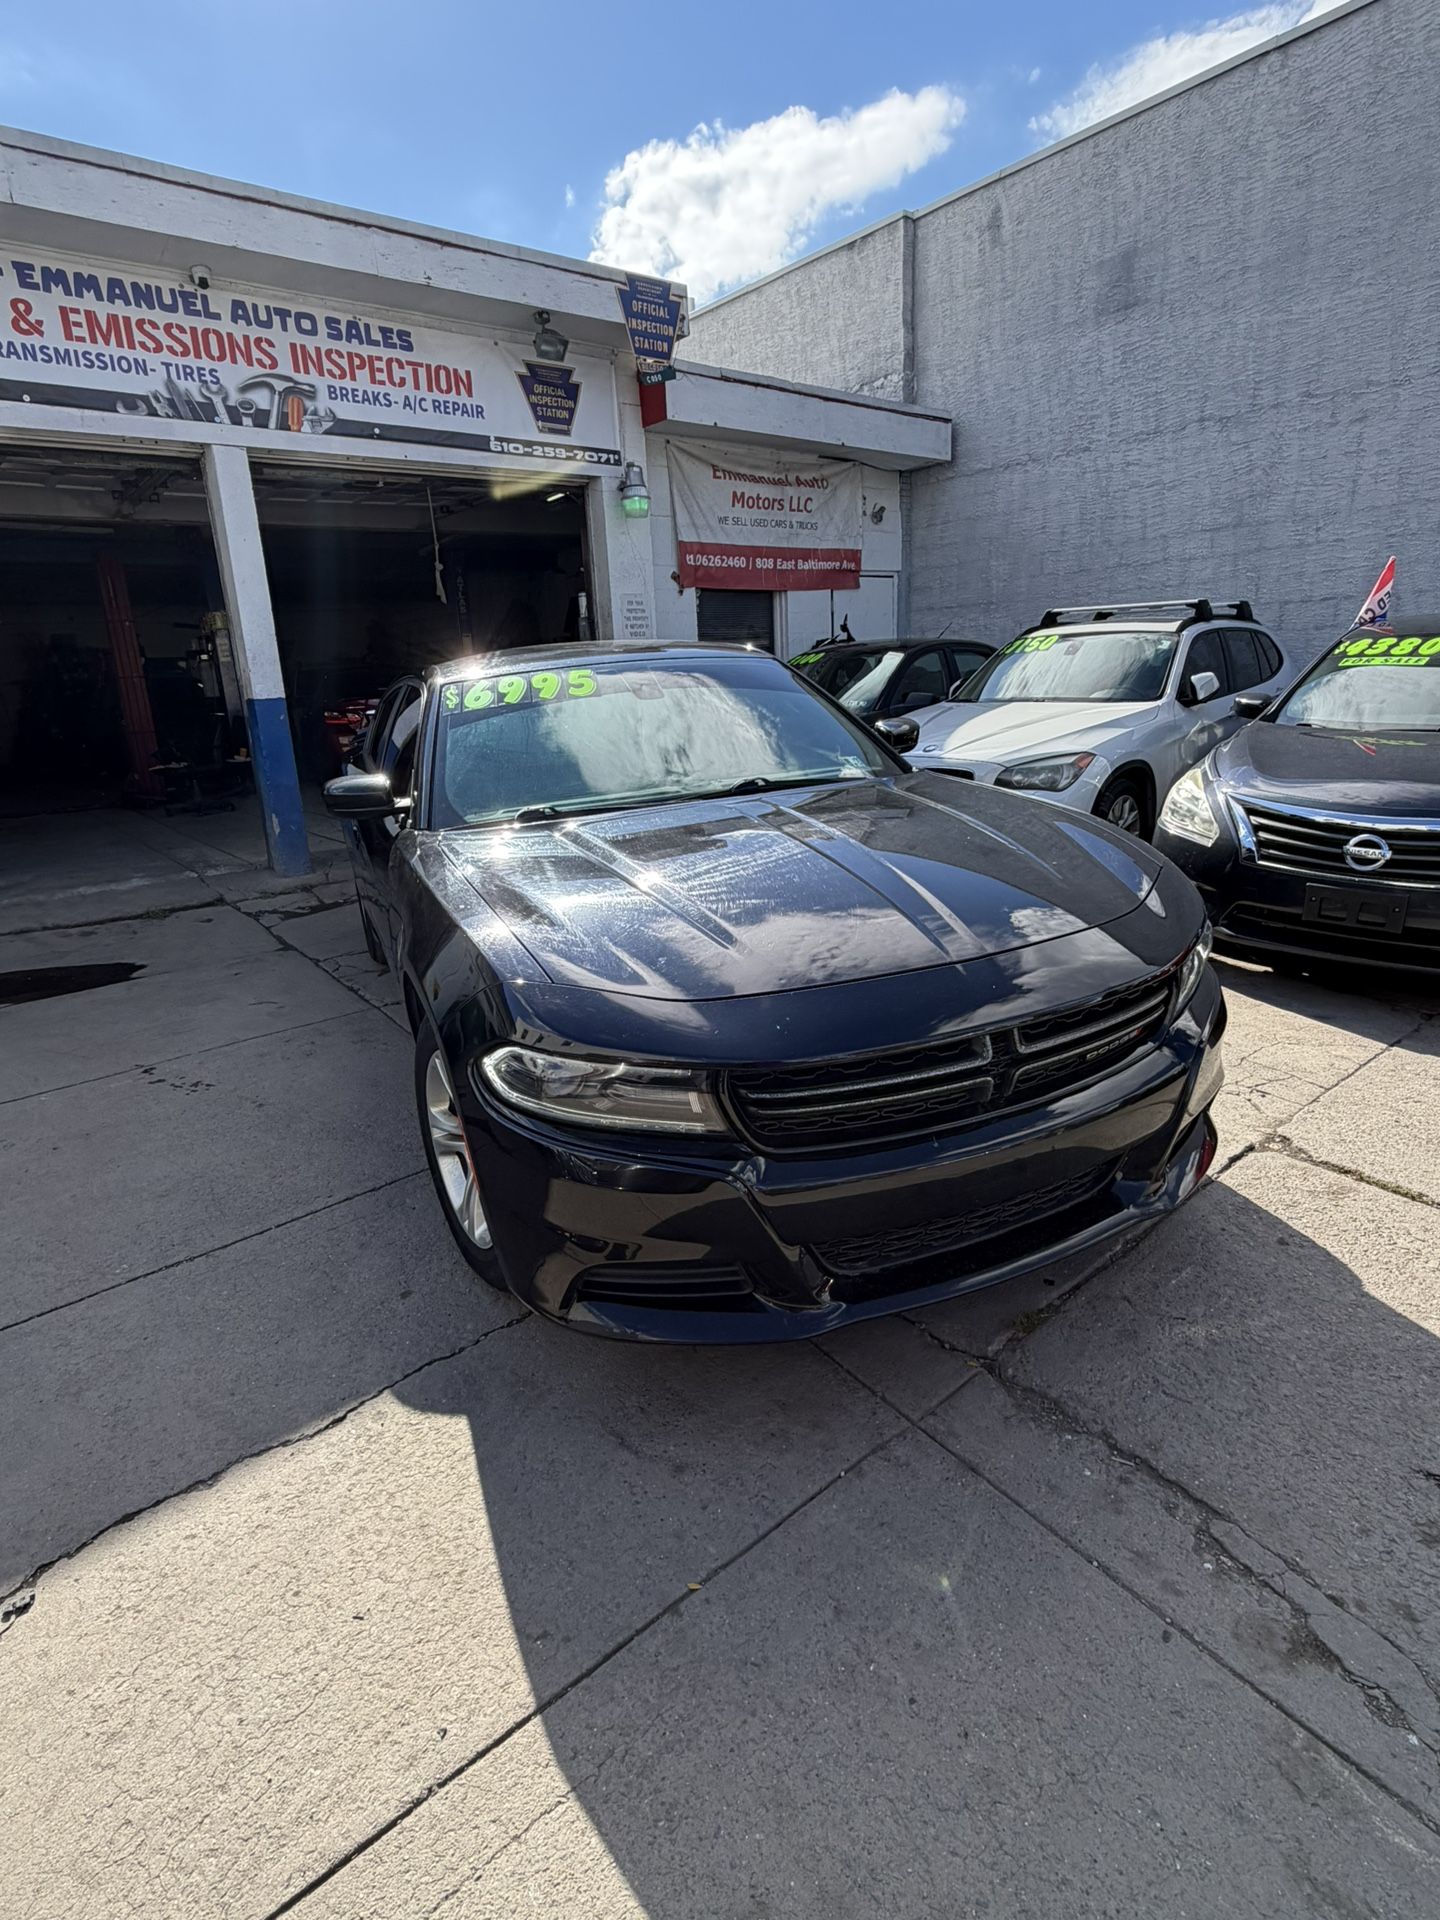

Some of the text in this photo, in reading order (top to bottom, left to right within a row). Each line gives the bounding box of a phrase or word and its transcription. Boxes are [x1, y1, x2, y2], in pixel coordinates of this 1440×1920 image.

[11, 260, 414, 352] EMMANUEL AUTO SALES
[632, 300, 670, 319] OFFICIAL
[628, 317, 674, 336] INSPECTION
[10, 298, 473, 399] & EMISSIONS INSPECTION
[634, 336, 668, 352] STATION
[160, 361, 221, 385] TIRES
[533, 383, 567, 397] OFFICIAL
[327, 385, 485, 420] BREAKS- A/C REPAIR
[529, 394, 575, 408] INSPECTION
[536, 406, 569, 419] STATION
[489, 440, 616, 464] 610-259-7071
[711, 463, 829, 489] Emmanuel Auto
[731, 490, 813, 513] Motors LLC
[718, 516, 818, 531] WE SELL USED CARS & TRUCKS
[755, 558, 774, 569] 808
[777, 559, 795, 569] East
[797, 559, 840, 570] Baltimore
[1380, 657, 1426, 666] SALE
[444, 668, 598, 710] $6995
[1346, 846, 1388, 859] NISSAN
[1086, 1030, 1138, 1060] DODGE
